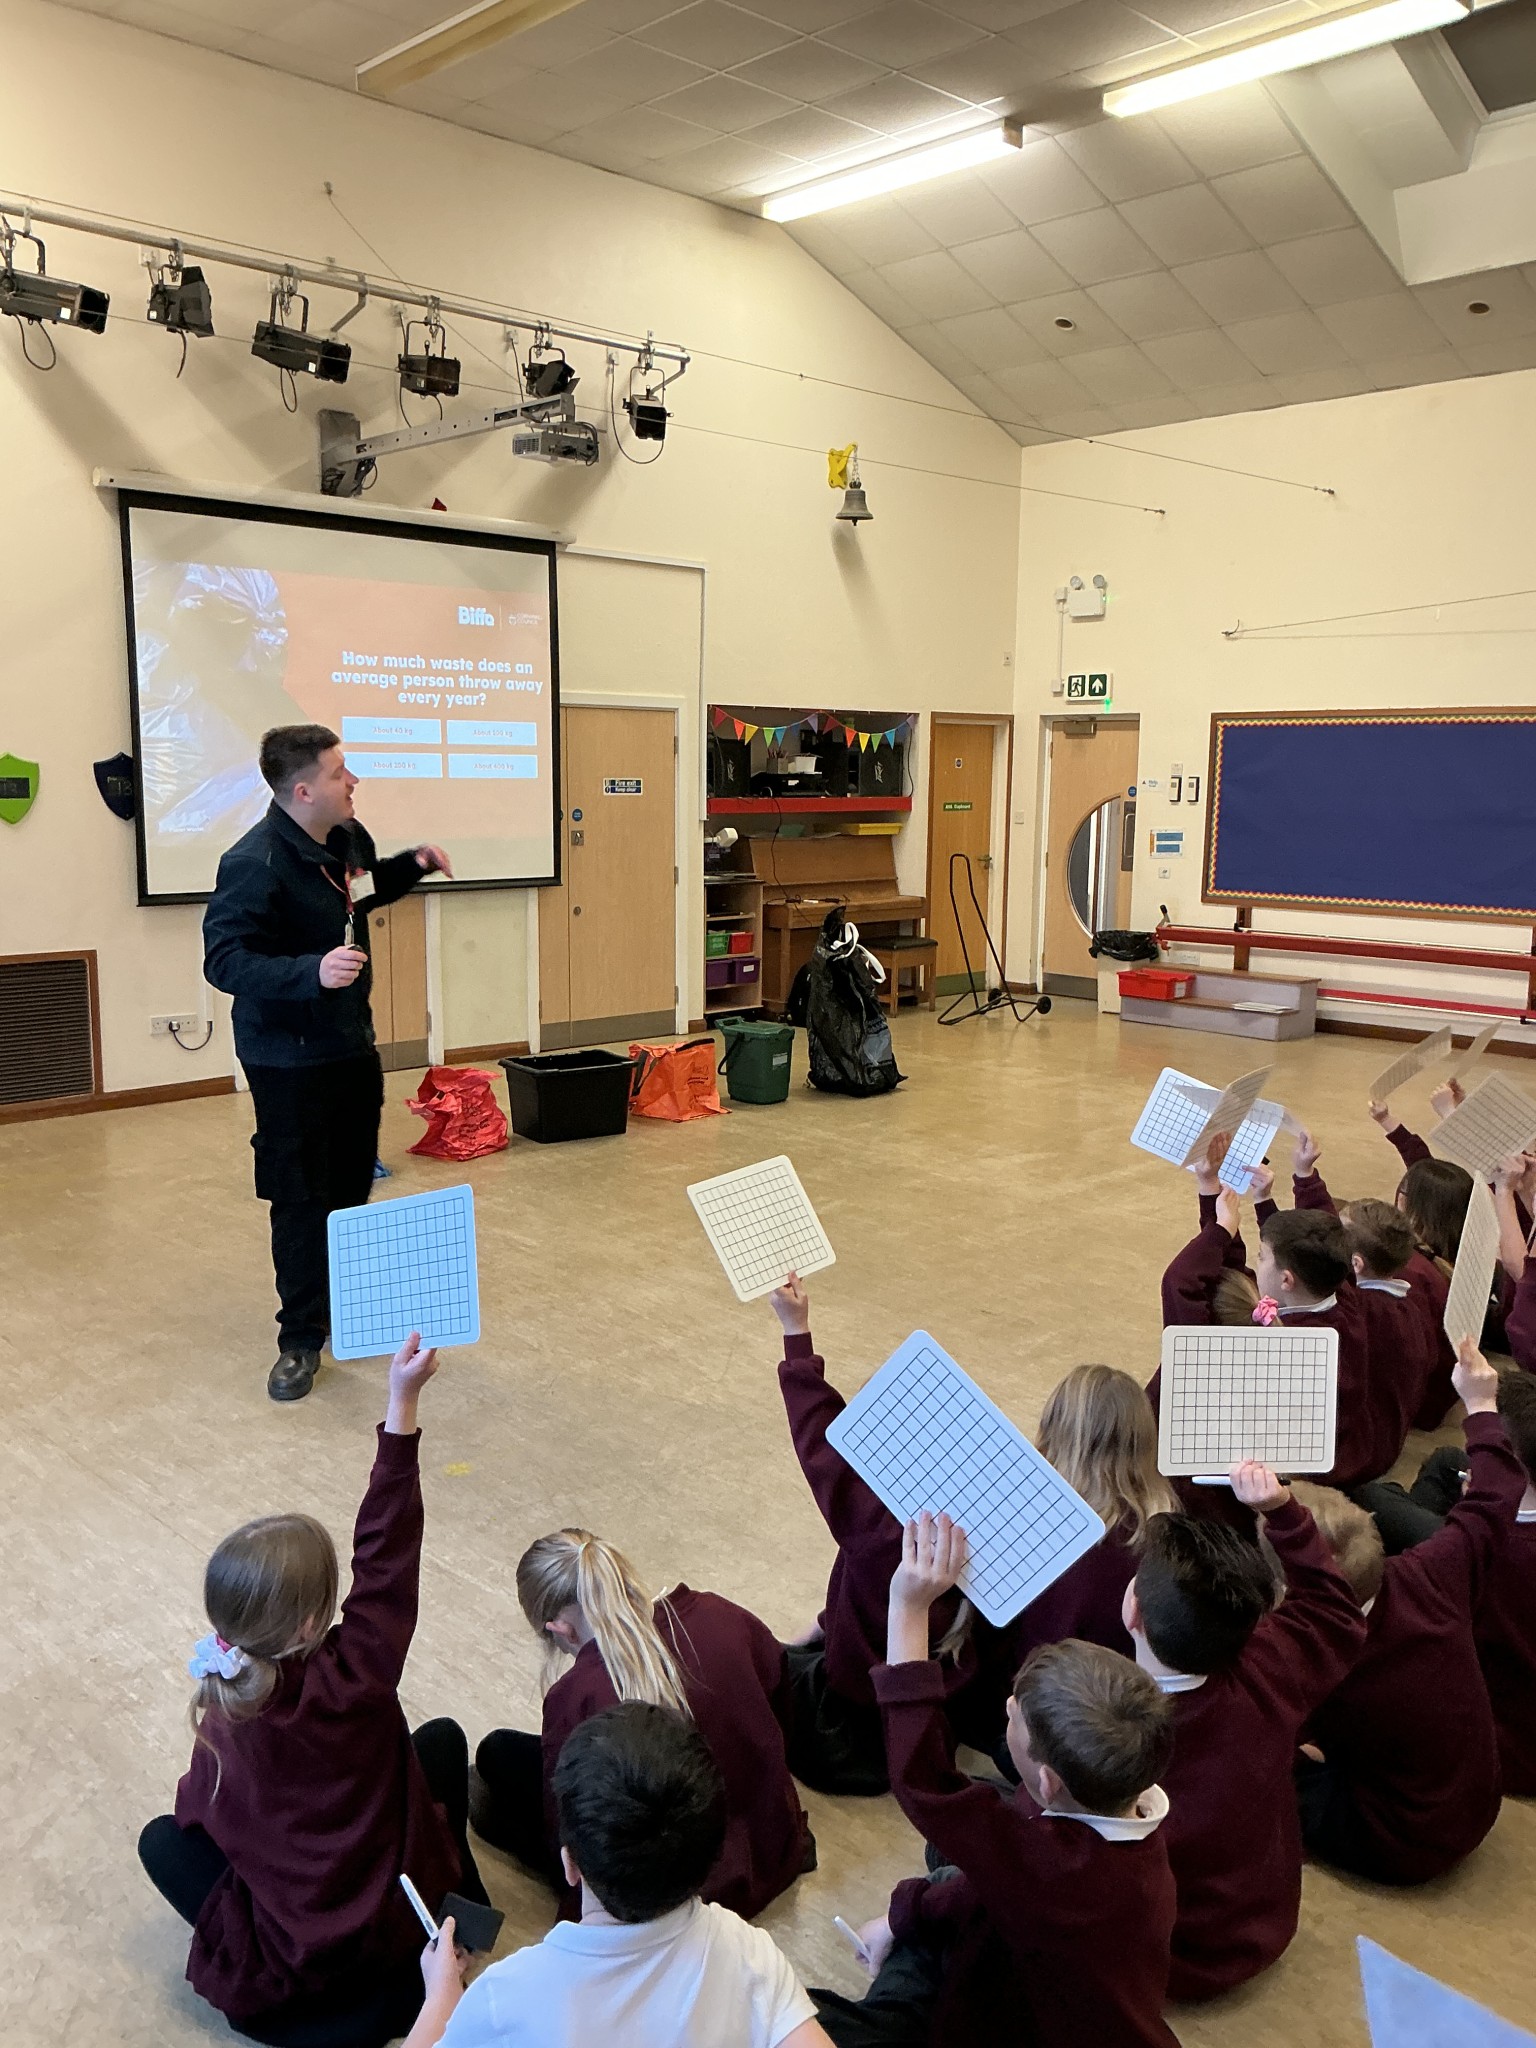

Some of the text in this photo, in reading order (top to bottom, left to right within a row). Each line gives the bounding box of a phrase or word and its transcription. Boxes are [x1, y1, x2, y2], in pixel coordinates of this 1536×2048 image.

[458, 605, 495, 626] Biffa
[342, 651, 533, 674] How much waste does an
[331, 671, 543, 695] average person throw away
[398, 692, 487, 708] every year?
[405, 727, 413, 735] kg
[505, 730, 513, 738] kg
[408, 762, 416, 770] kg
[507, 763, 514, 771] kg
